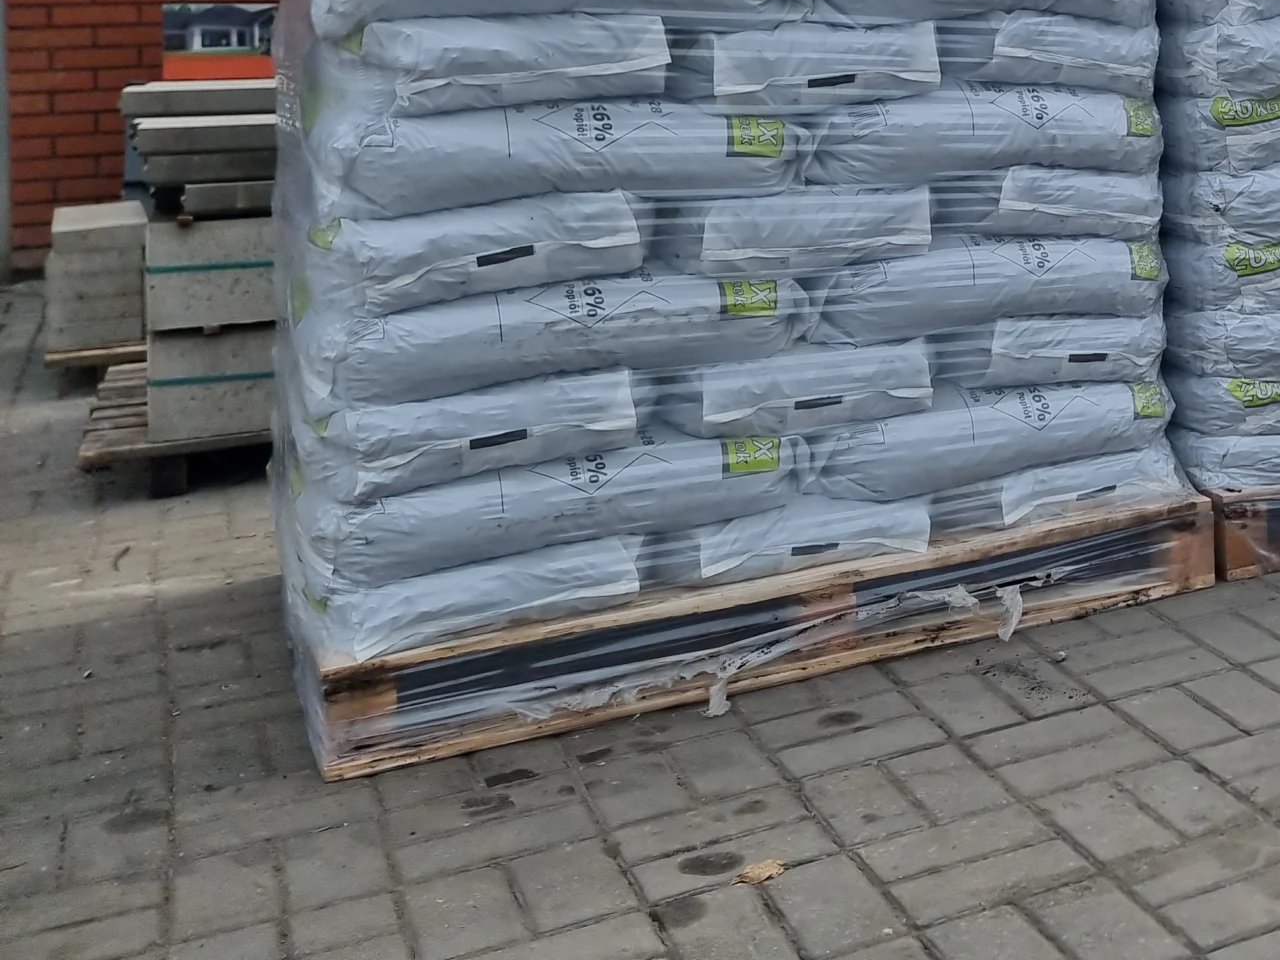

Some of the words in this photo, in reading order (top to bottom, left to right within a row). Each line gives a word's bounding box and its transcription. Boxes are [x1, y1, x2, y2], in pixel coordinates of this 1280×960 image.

[1015, 90, 1031, 117] Popiół
[573, 106, 586, 137] Popiół
[1015, 240, 1032, 266] Popiół
[564, 283, 579, 315] Popiół
[1016, 391, 1033, 420] Popiół
